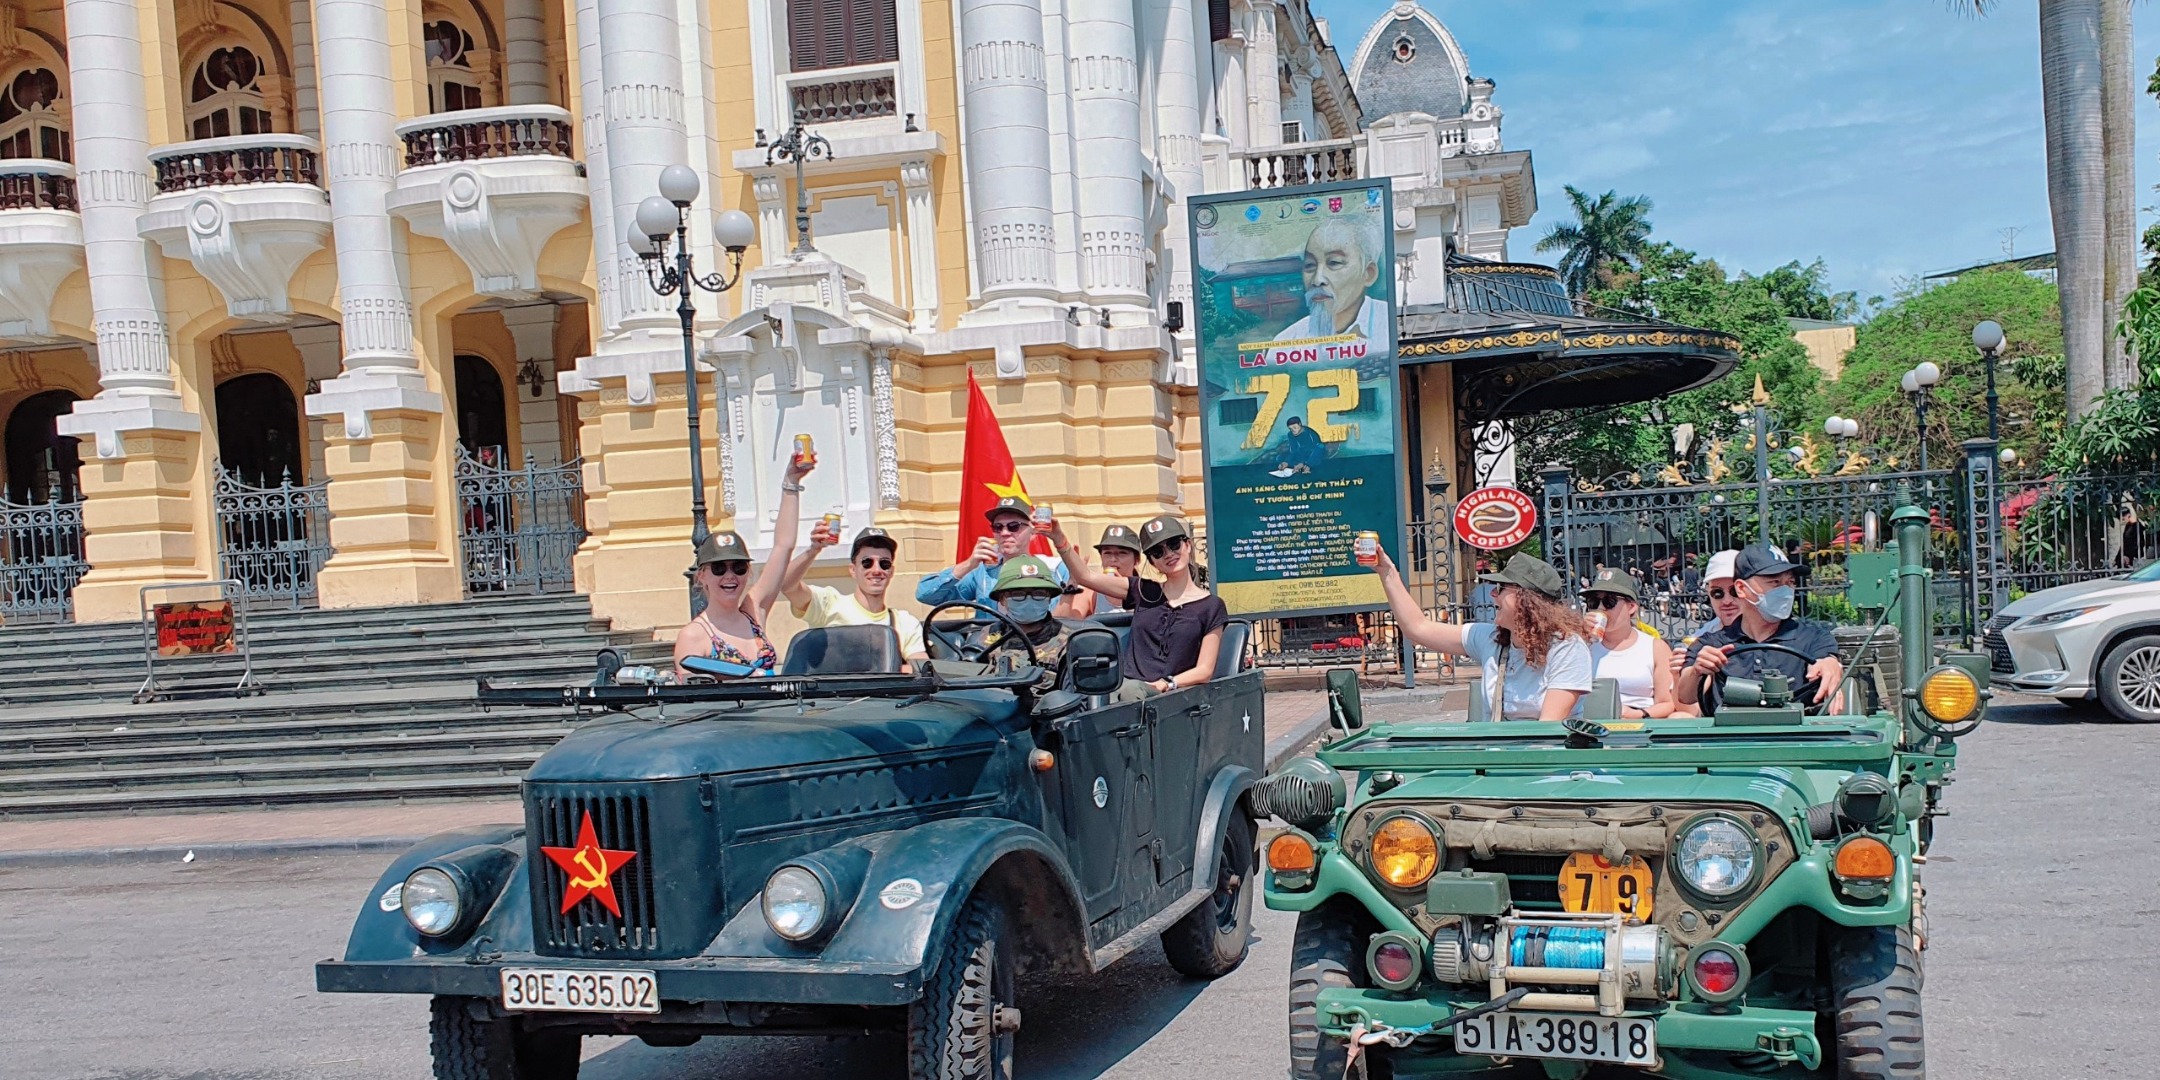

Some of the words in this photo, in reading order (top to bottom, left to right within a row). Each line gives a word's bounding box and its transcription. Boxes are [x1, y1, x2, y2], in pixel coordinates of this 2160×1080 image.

[1235, 368, 1361, 450] 72
[1277, 482, 1299, 491] CÔNG
[1325, 491, 1345, 499] MINH
[1457, 490, 1531, 519] HIGHLANDS
[1468, 528, 1525, 546] COFFEE
